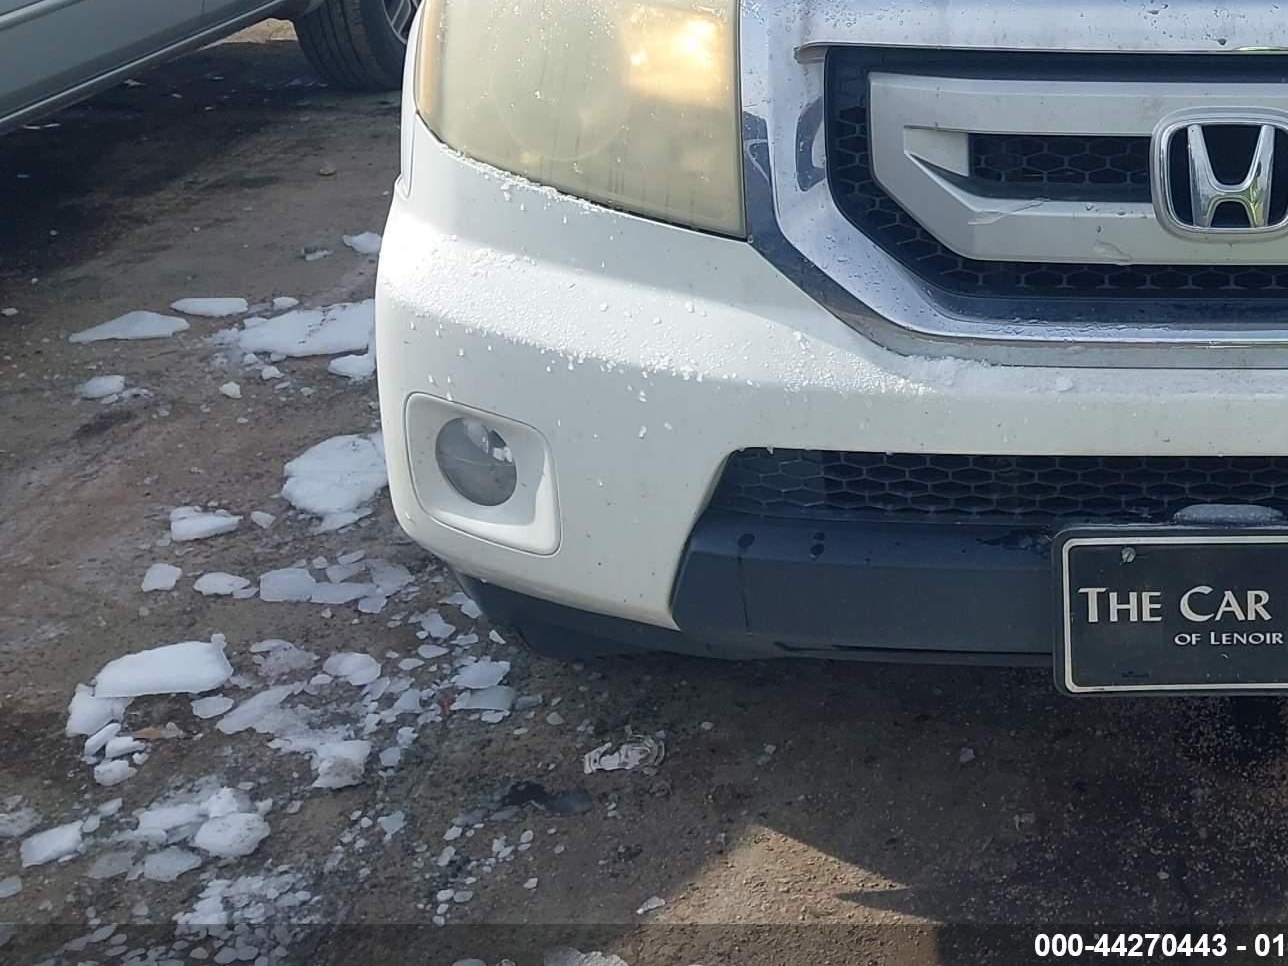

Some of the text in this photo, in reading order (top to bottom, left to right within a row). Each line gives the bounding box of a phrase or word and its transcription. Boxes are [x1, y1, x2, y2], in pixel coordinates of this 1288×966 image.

[1078, 587, 1162, 623] THE
[1179, 585, 1272, 622] CAR
[1174, 631, 1284, 646] OF LENOIR
